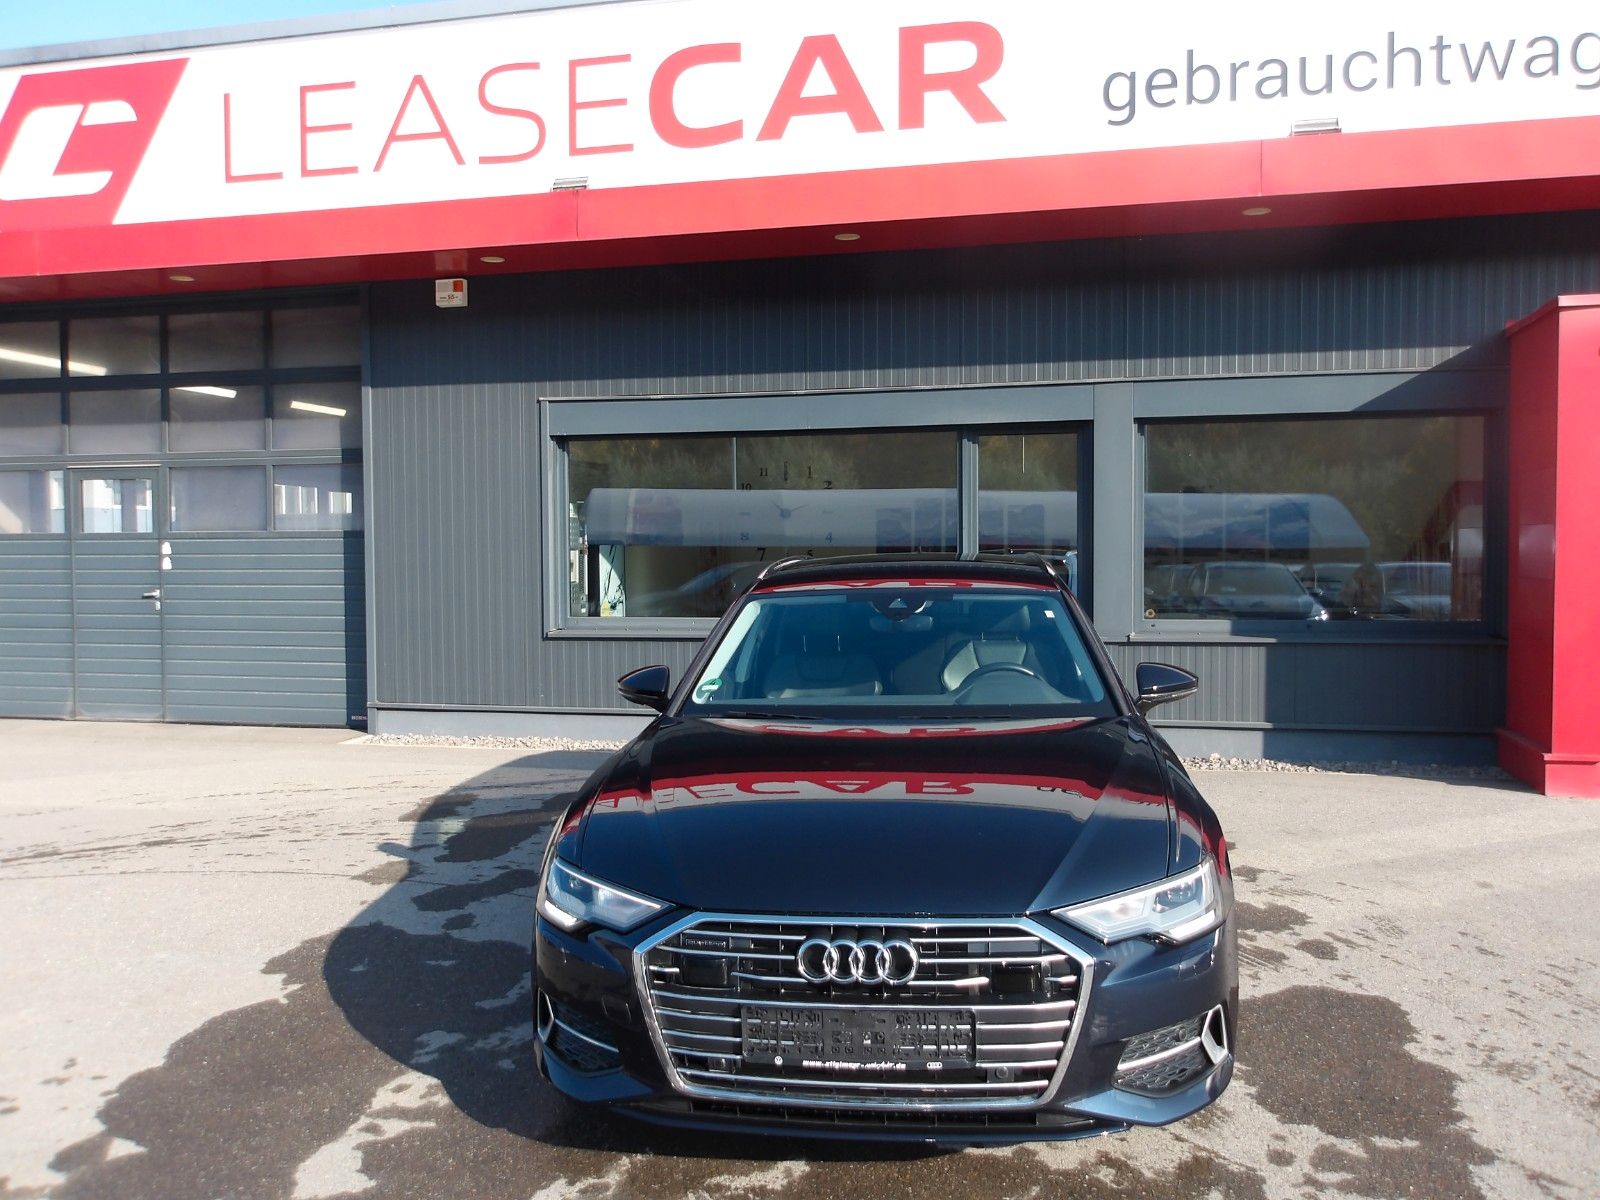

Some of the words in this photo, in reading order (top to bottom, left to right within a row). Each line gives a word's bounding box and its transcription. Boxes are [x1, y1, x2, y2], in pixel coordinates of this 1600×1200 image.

[224, 22, 1005, 184] LEASECAR
[1102, 32, 1600, 127] gebrauchtwag
[823, 481, 833, 490] 2
[756, 547, 767, 561] 7
